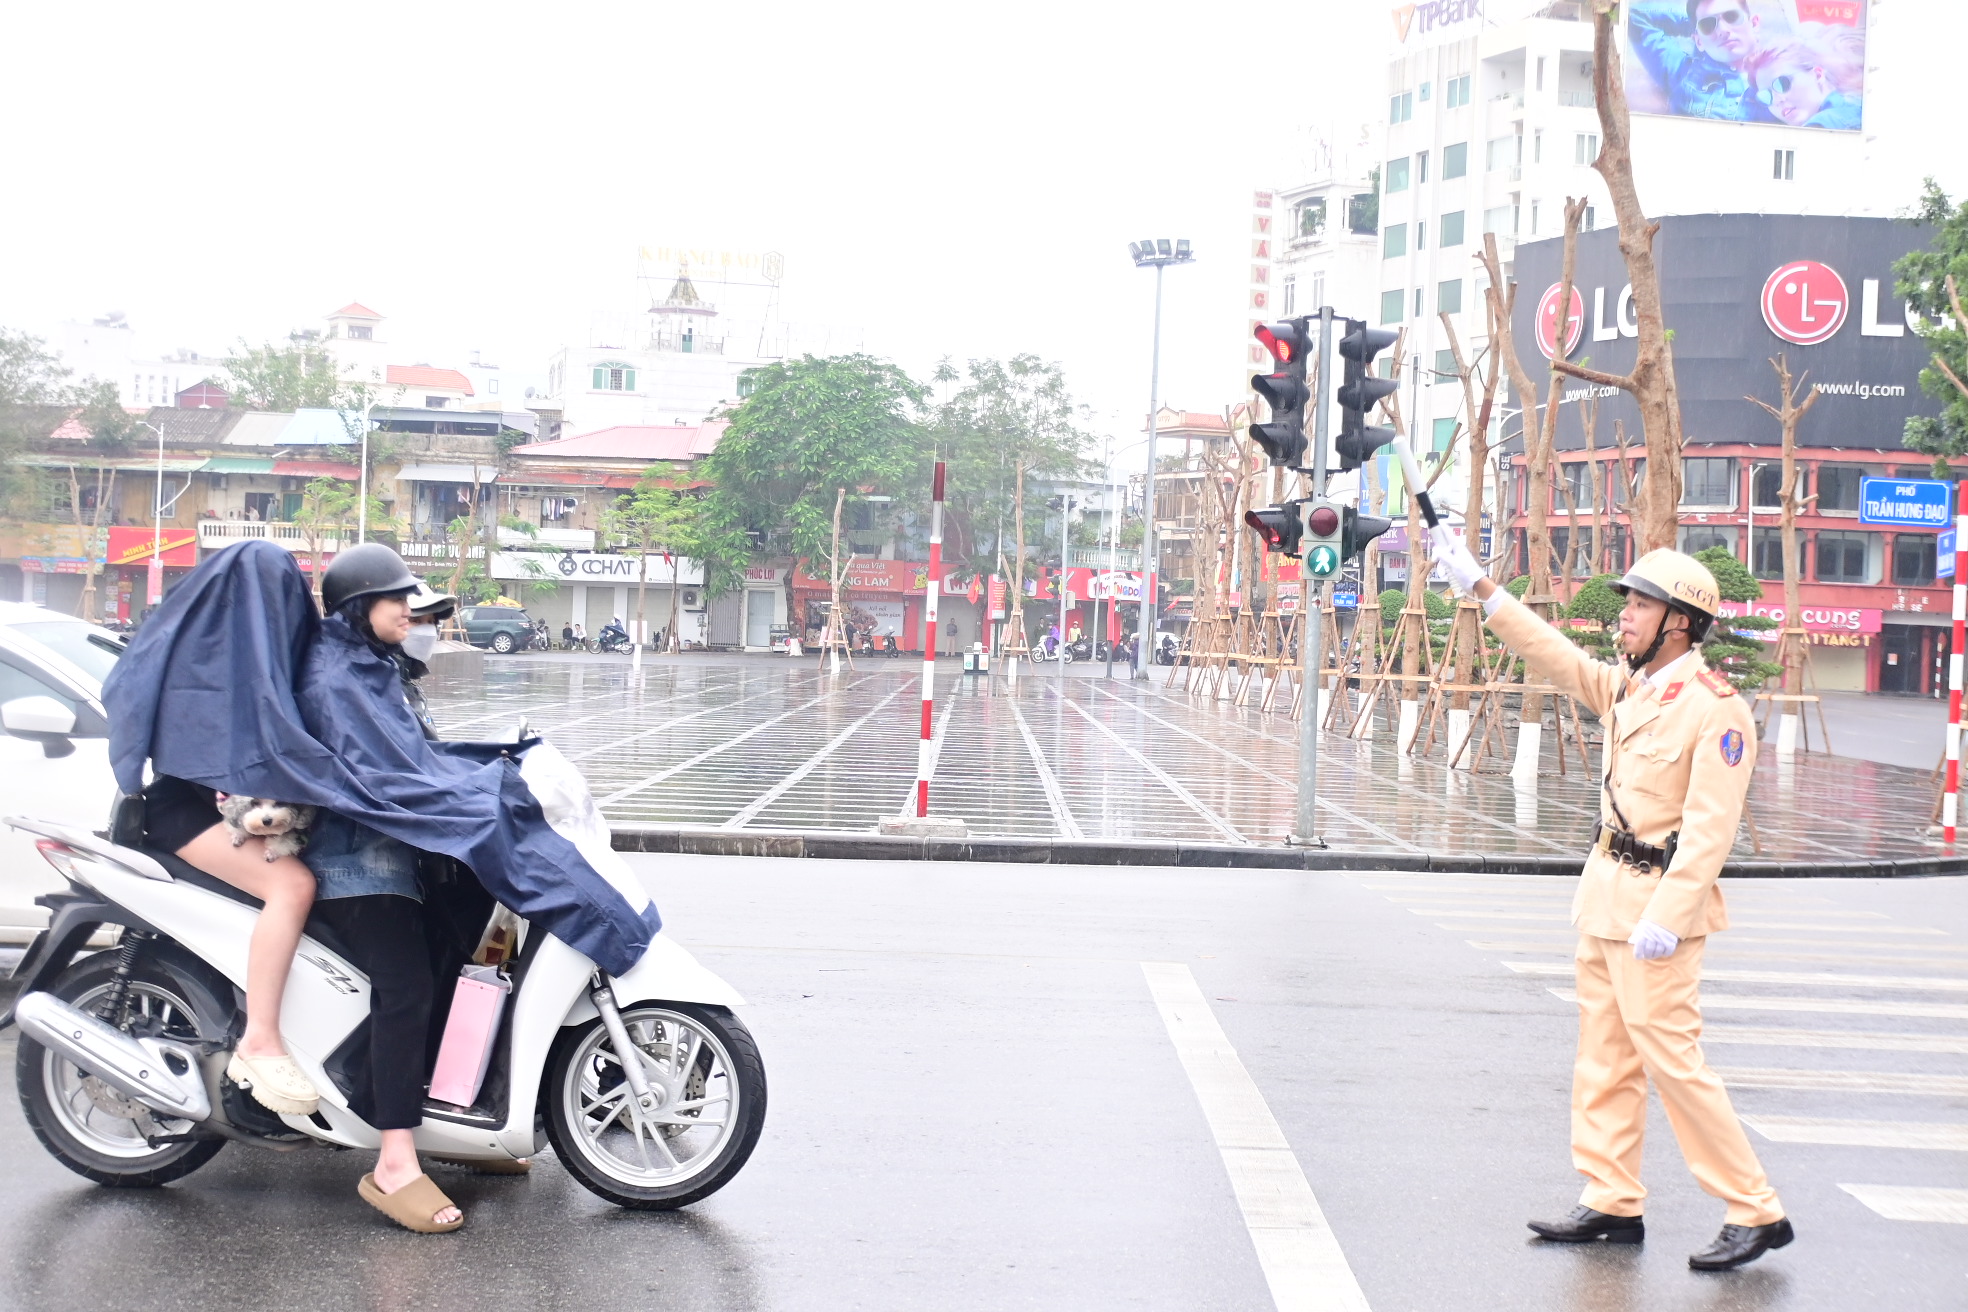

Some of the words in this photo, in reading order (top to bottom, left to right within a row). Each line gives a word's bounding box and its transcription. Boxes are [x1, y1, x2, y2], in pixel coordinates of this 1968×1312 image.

[1416, 0, 1482, 34] TPBank
[1813, 381, 1906, 400] www.lg.com
[1896, 484, 1917, 497] PHỐ
[1866, 496, 1894, 517] TRẦN
[1924, 504, 1946, 523] ĐẠO
[401, 538, 429, 557] BÁNH
[865, 577, 889, 587] LAM
[1674, 580, 1716, 608] CSGT
